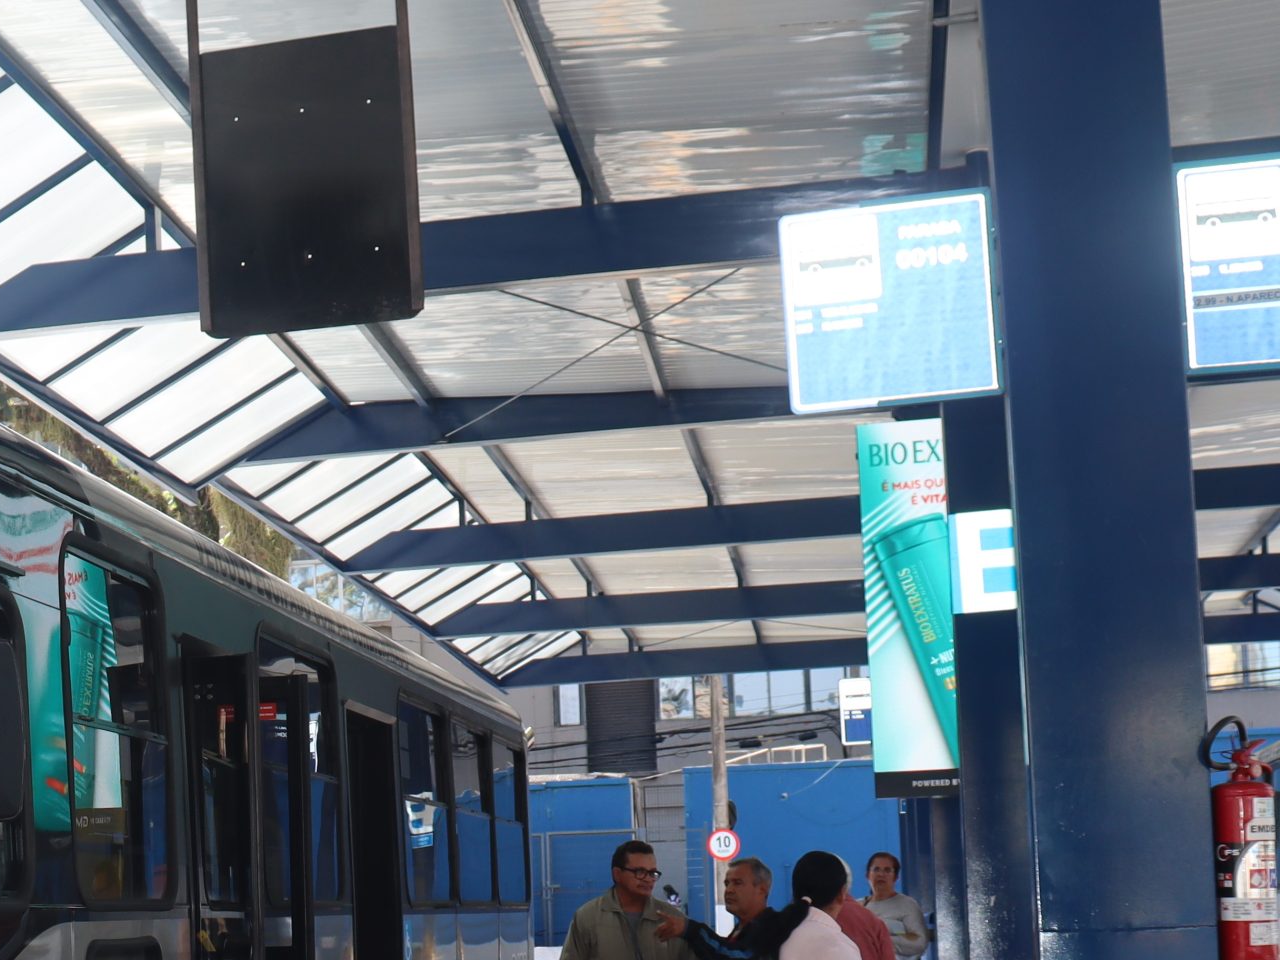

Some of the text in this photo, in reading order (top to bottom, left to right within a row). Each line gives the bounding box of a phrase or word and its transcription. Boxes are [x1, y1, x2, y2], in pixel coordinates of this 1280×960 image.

[869, 441, 907, 468] BIO
[882, 480, 888, 492] É
[893, 479, 921, 491] MAIS
[912, 493, 949, 505] É VITA
[957, 510, 1017, 613] E
[912, 779, 951, 787] POWERED
[716, 836, 731, 848] 10
